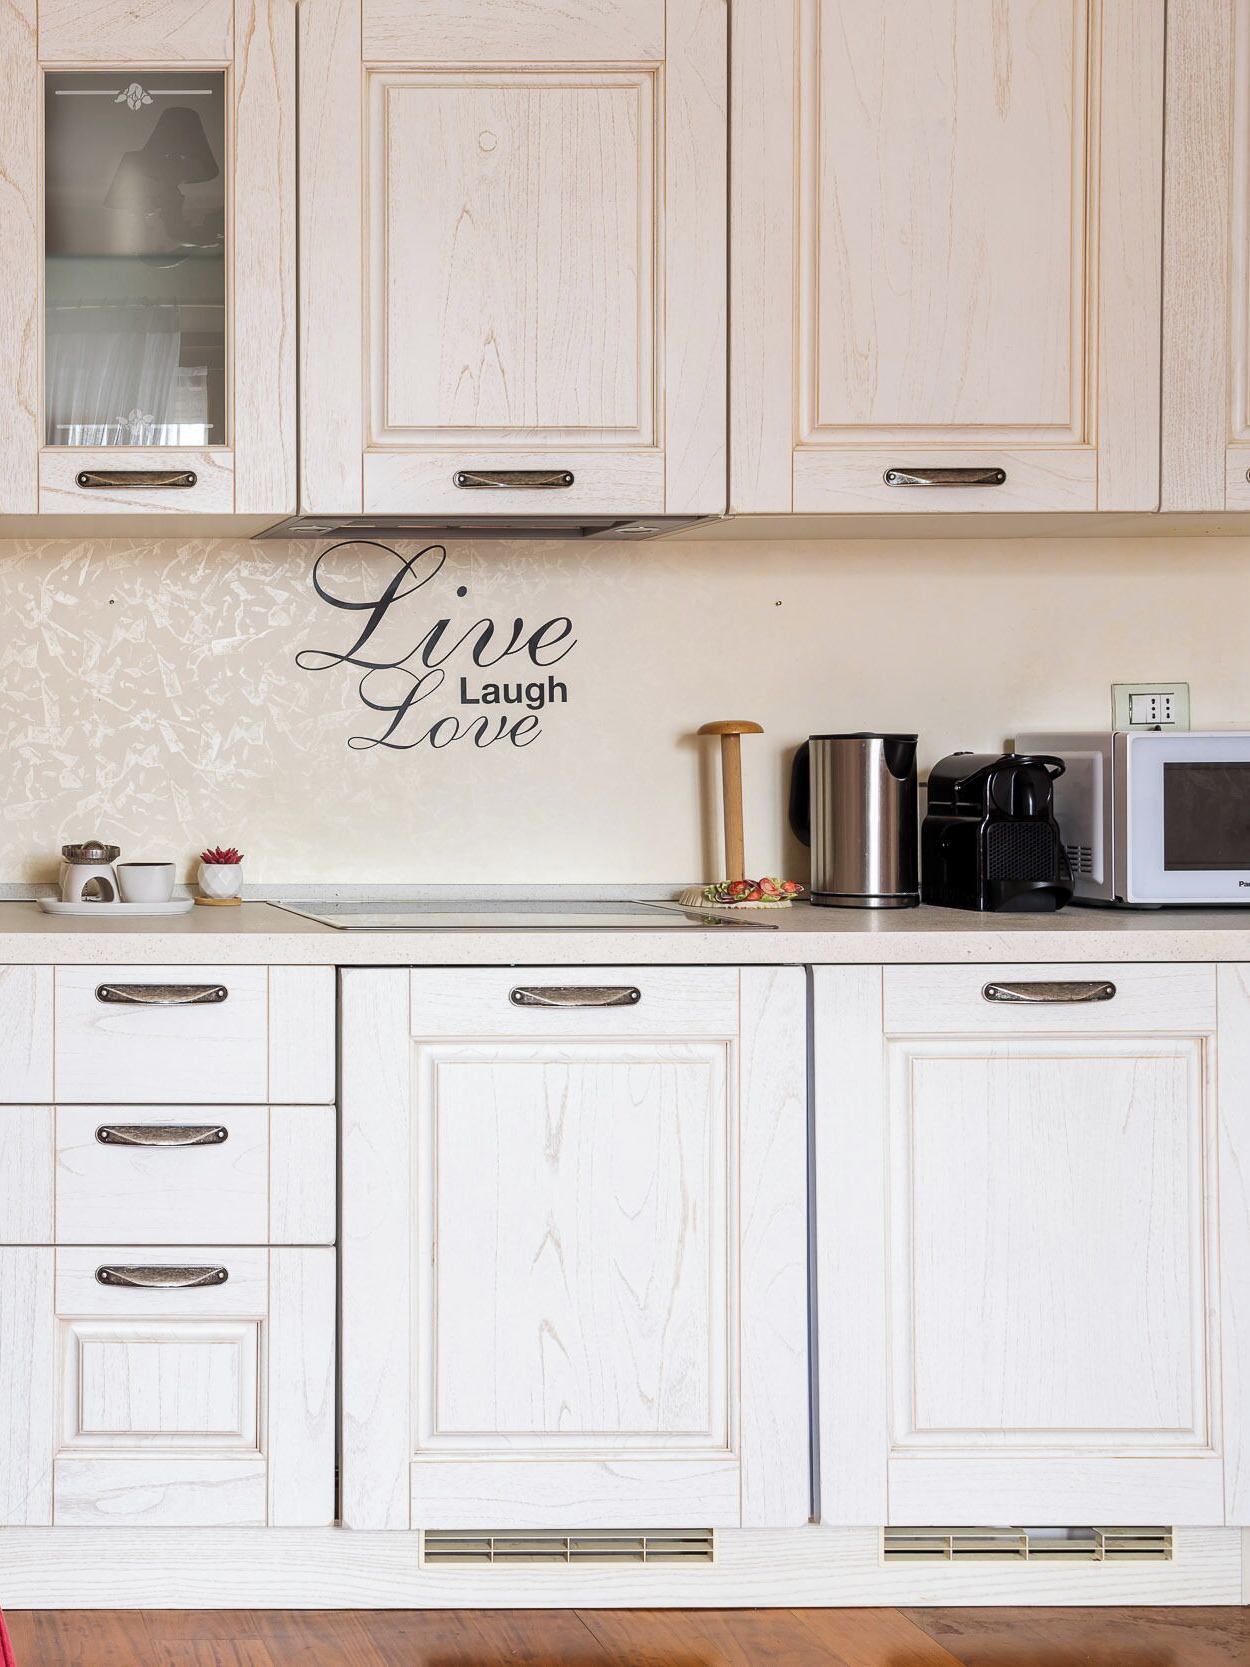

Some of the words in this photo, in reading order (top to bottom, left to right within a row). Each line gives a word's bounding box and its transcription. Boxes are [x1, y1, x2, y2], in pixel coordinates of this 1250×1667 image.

[295, 540, 578, 671] Live
[347, 666, 543, 750] Love
[460, 675, 568, 710] Laugh
